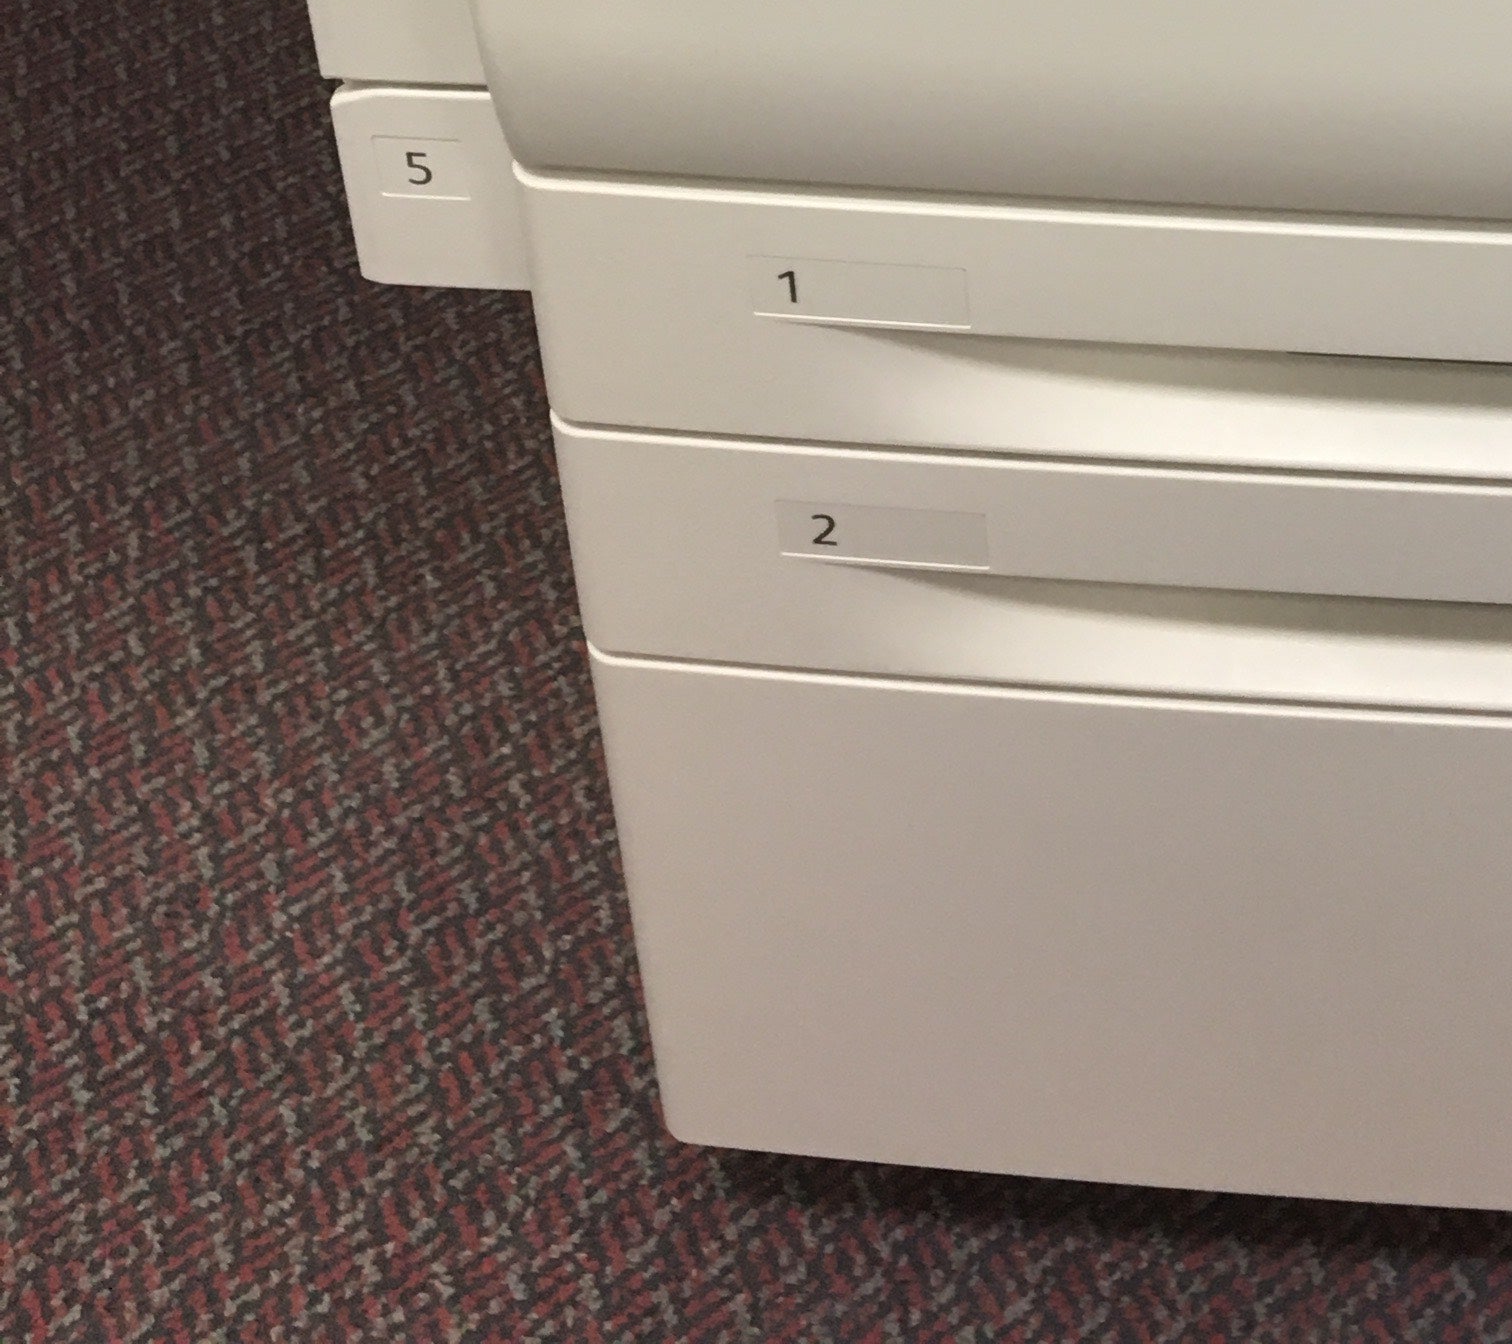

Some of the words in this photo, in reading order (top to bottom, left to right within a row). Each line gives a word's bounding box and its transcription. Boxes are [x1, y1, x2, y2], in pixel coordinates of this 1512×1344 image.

[405, 151, 433, 185] 5
[776, 270, 799, 304] 1
[810, 513, 839, 547] 2
